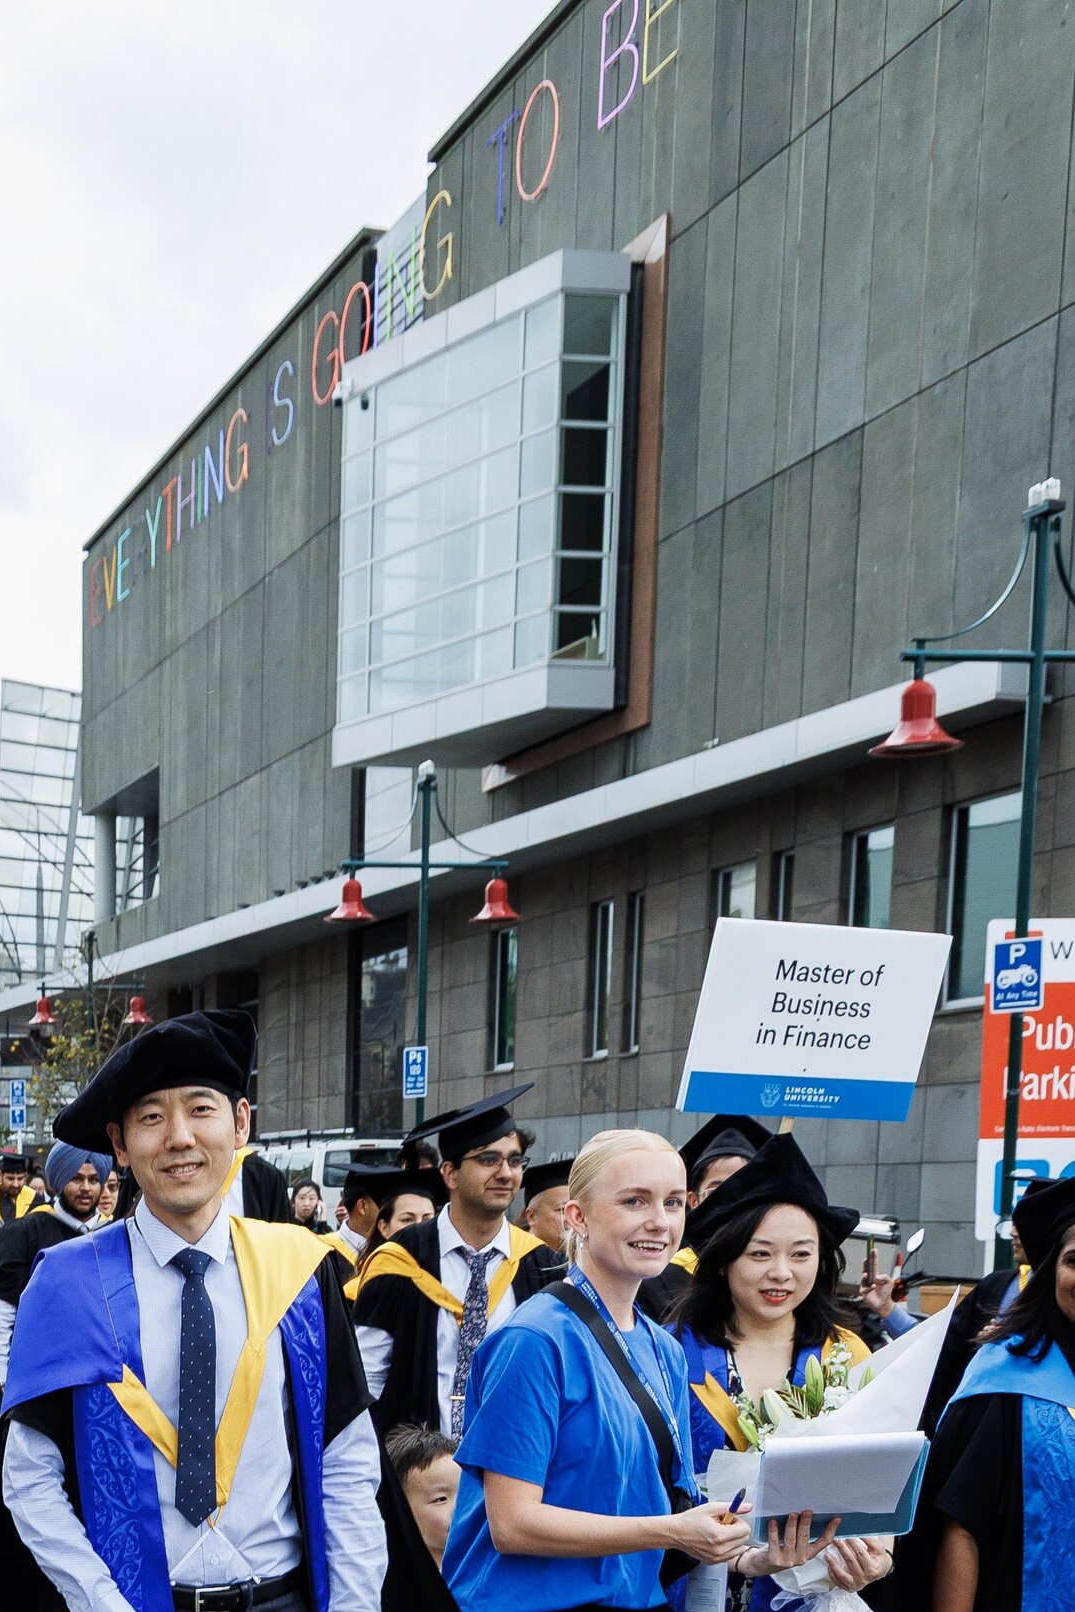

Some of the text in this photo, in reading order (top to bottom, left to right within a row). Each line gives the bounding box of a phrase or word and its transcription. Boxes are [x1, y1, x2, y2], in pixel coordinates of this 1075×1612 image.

[311, 190, 454, 406] GOING
[484, 79, 560, 226] TO
[597, 0, 680, 131] BE
[1009, 943, 1027, 965] P
[775, 959, 886, 987] Master of
[771, 991, 872, 1018] Business
[756, 1022, 872, 1050] in Finance
[1021, 1015, 1075, 1050] Pub
[784, 1094, 840, 1103] UNIVERSITY
[785, 1086, 825, 1095] LINCOLN
